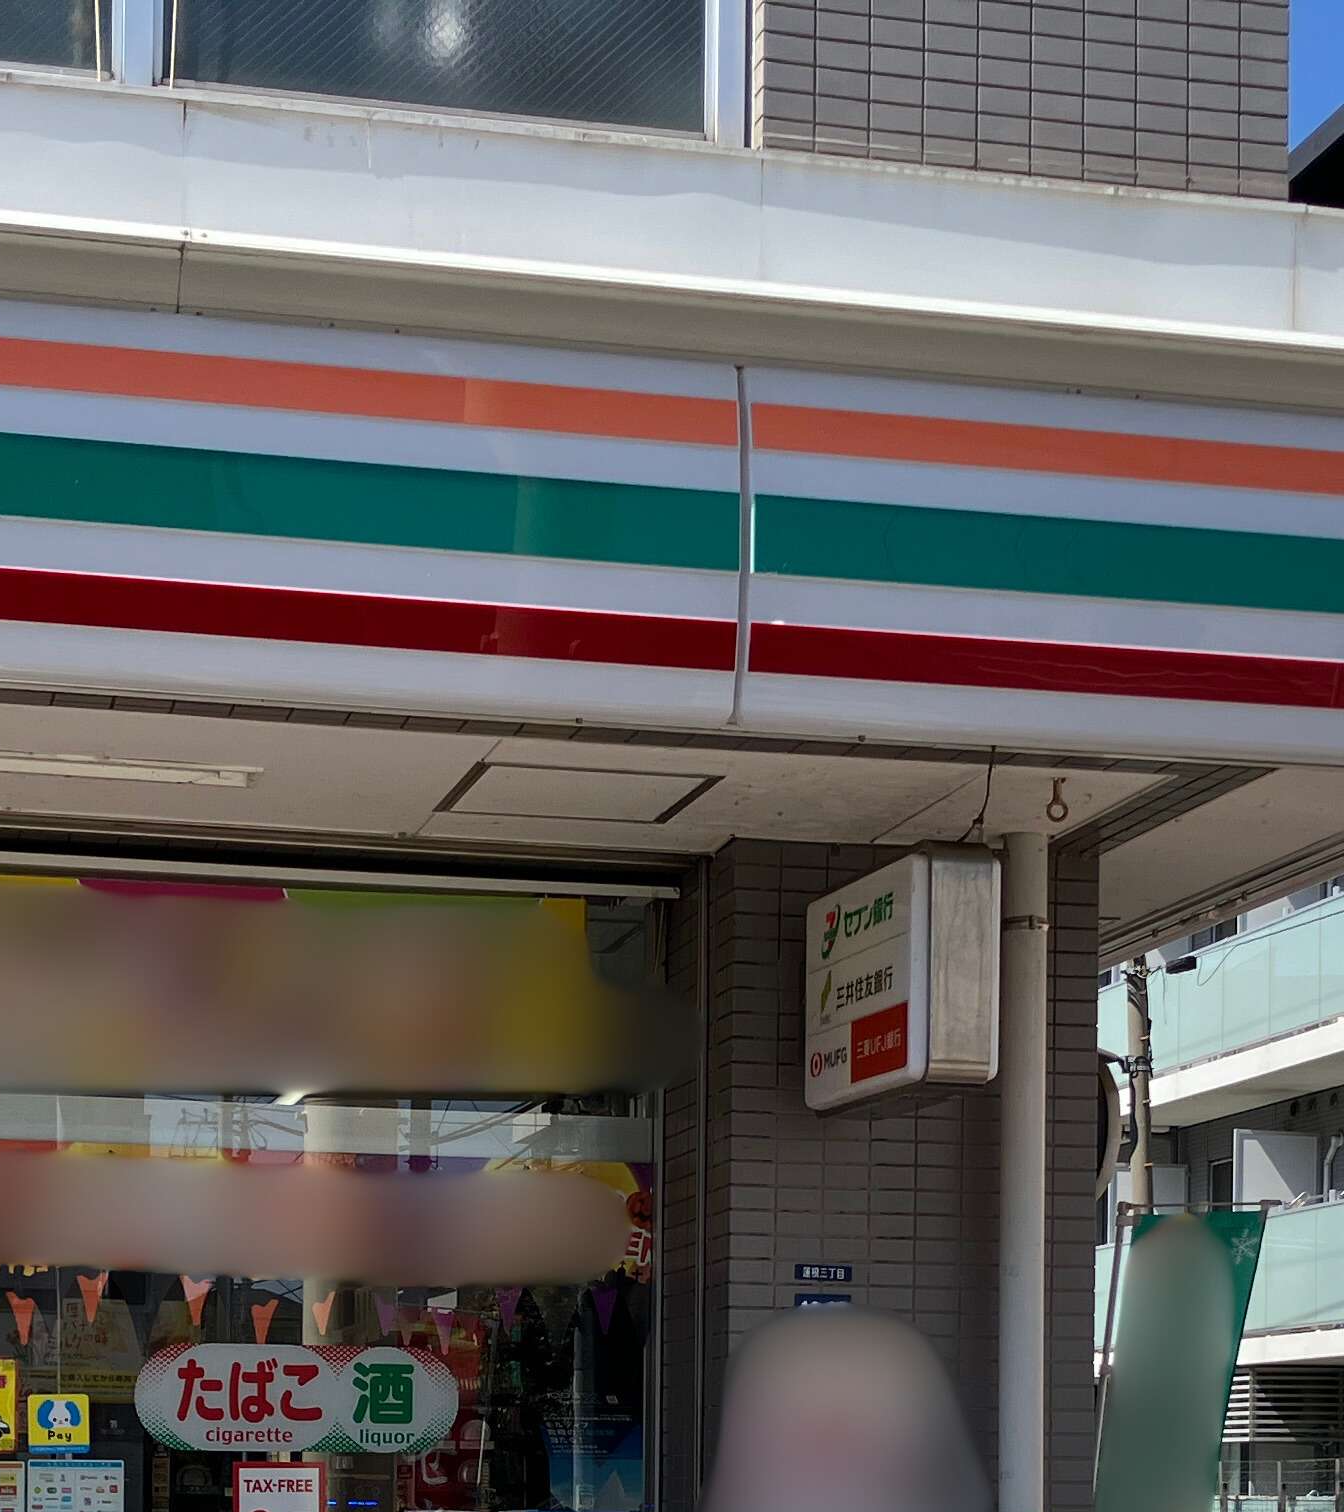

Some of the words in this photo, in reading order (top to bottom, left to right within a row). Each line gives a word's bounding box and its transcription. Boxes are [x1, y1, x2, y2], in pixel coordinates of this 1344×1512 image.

[844, 892, 893, 937] セブン銀行
[836, 966, 892, 1010] 三井住友銀行
[824, 1047, 847, 1068] MUFG
[177, 1357, 323, 1423] たばこ
[351, 1361, 415, 1425] 酒
[47, 1430, 72, 1442] Pay
[205, 1427, 293, 1445] cigarette
[359, 1429, 415, 1446] liquor
[242, 1478, 314, 1493] TAX-FREE
